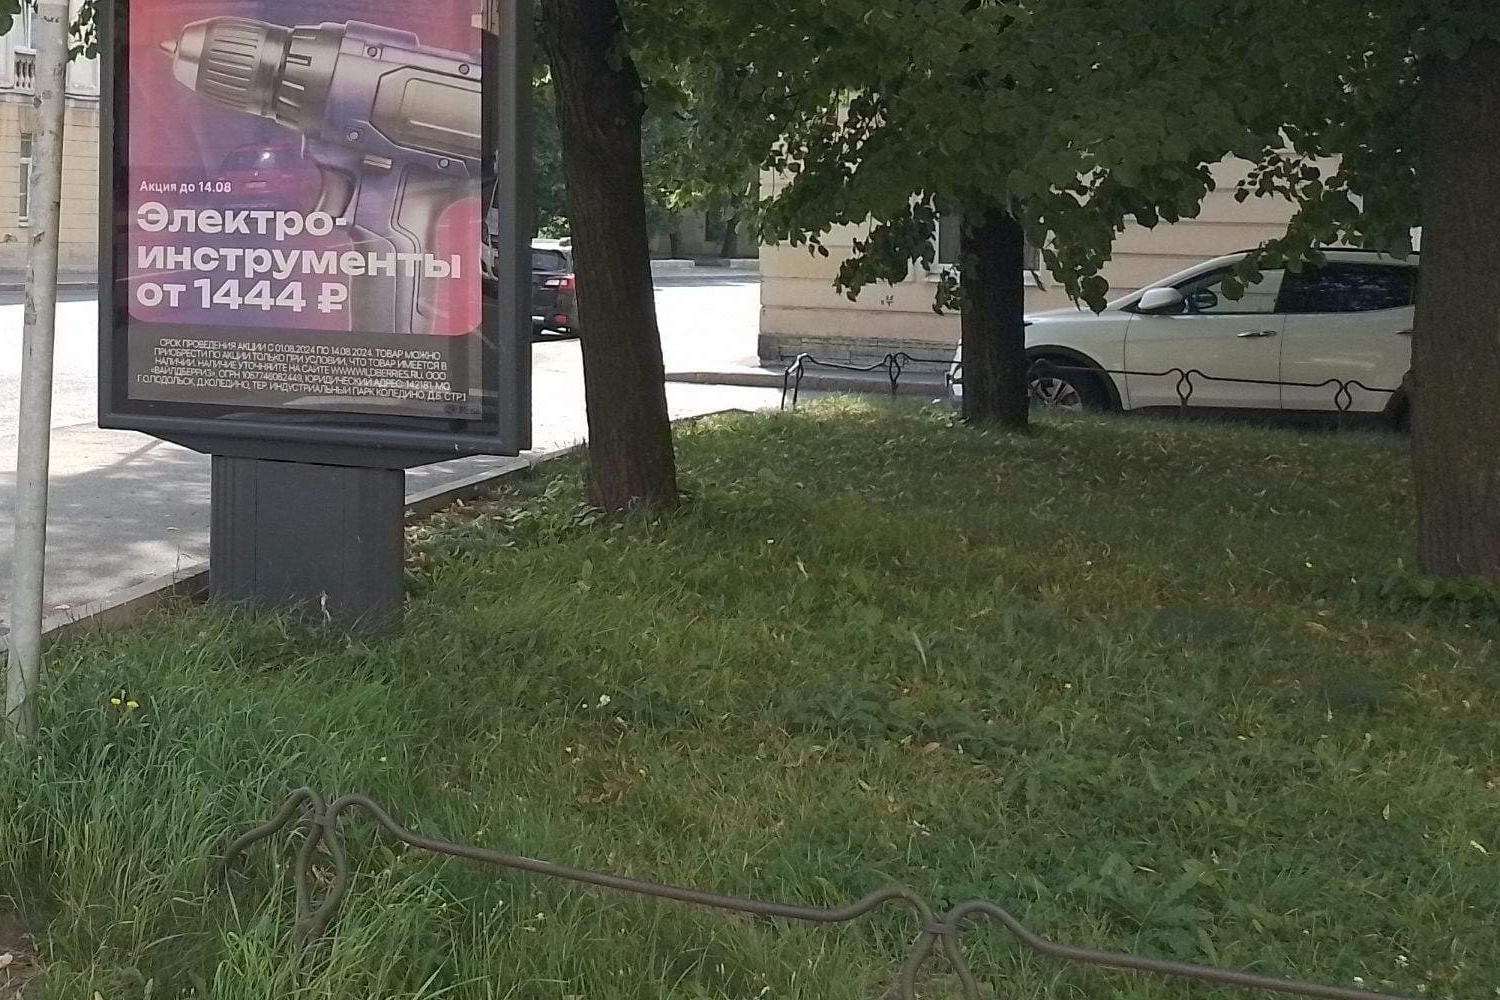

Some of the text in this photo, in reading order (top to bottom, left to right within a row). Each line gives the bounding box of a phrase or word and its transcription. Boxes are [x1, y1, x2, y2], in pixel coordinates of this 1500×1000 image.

[139, 181, 232, 194] Акция до 14.08
[137, 201, 347, 241] Электро-
[137, 245, 461, 280] инструменты
[136, 282, 186, 308] от
[193, 278, 306, 313] 1444
[154, 347, 448, 371] ПРИОБРЕСТИ ПО АКЦИИ ТОЛЬКО ПРИ УСЛОВИИ, ЧТО ТОВАР ИМЕЕТСЯ В
[159, 338, 182, 347] СРОК
[182, 339, 237, 350] ПРОВЕДЕНИЯ
[237, 342, 267, 352] АКЦИИ
[268, 343, 274, 352] С
[275, 343, 315, 354] 01.08.2024
[317, 345, 330, 355] ПО
[375, 348, 404, 359] ТОВАР
[404, 350, 442, 360] МОЖНО
[198, 359, 238, 369] НАЛИЧИЕ
[238, 361, 288, 372] УТОЧНЯЙТЕ
[288, 363, 301, 373] НА
[301, 364, 330, 374] САЙТЕ
[425, 371, 447, 381] ООО
[219, 369, 241, 379] ОГРН
[304, 374, 373, 387] ЮРИДИЧЕСКИЙ
[373, 378, 405, 389] АДРЕС:
[269, 382, 352, 395] ИНДУСТРИАЛЬНЫЙ
[352, 386, 375, 396] ПАРК
